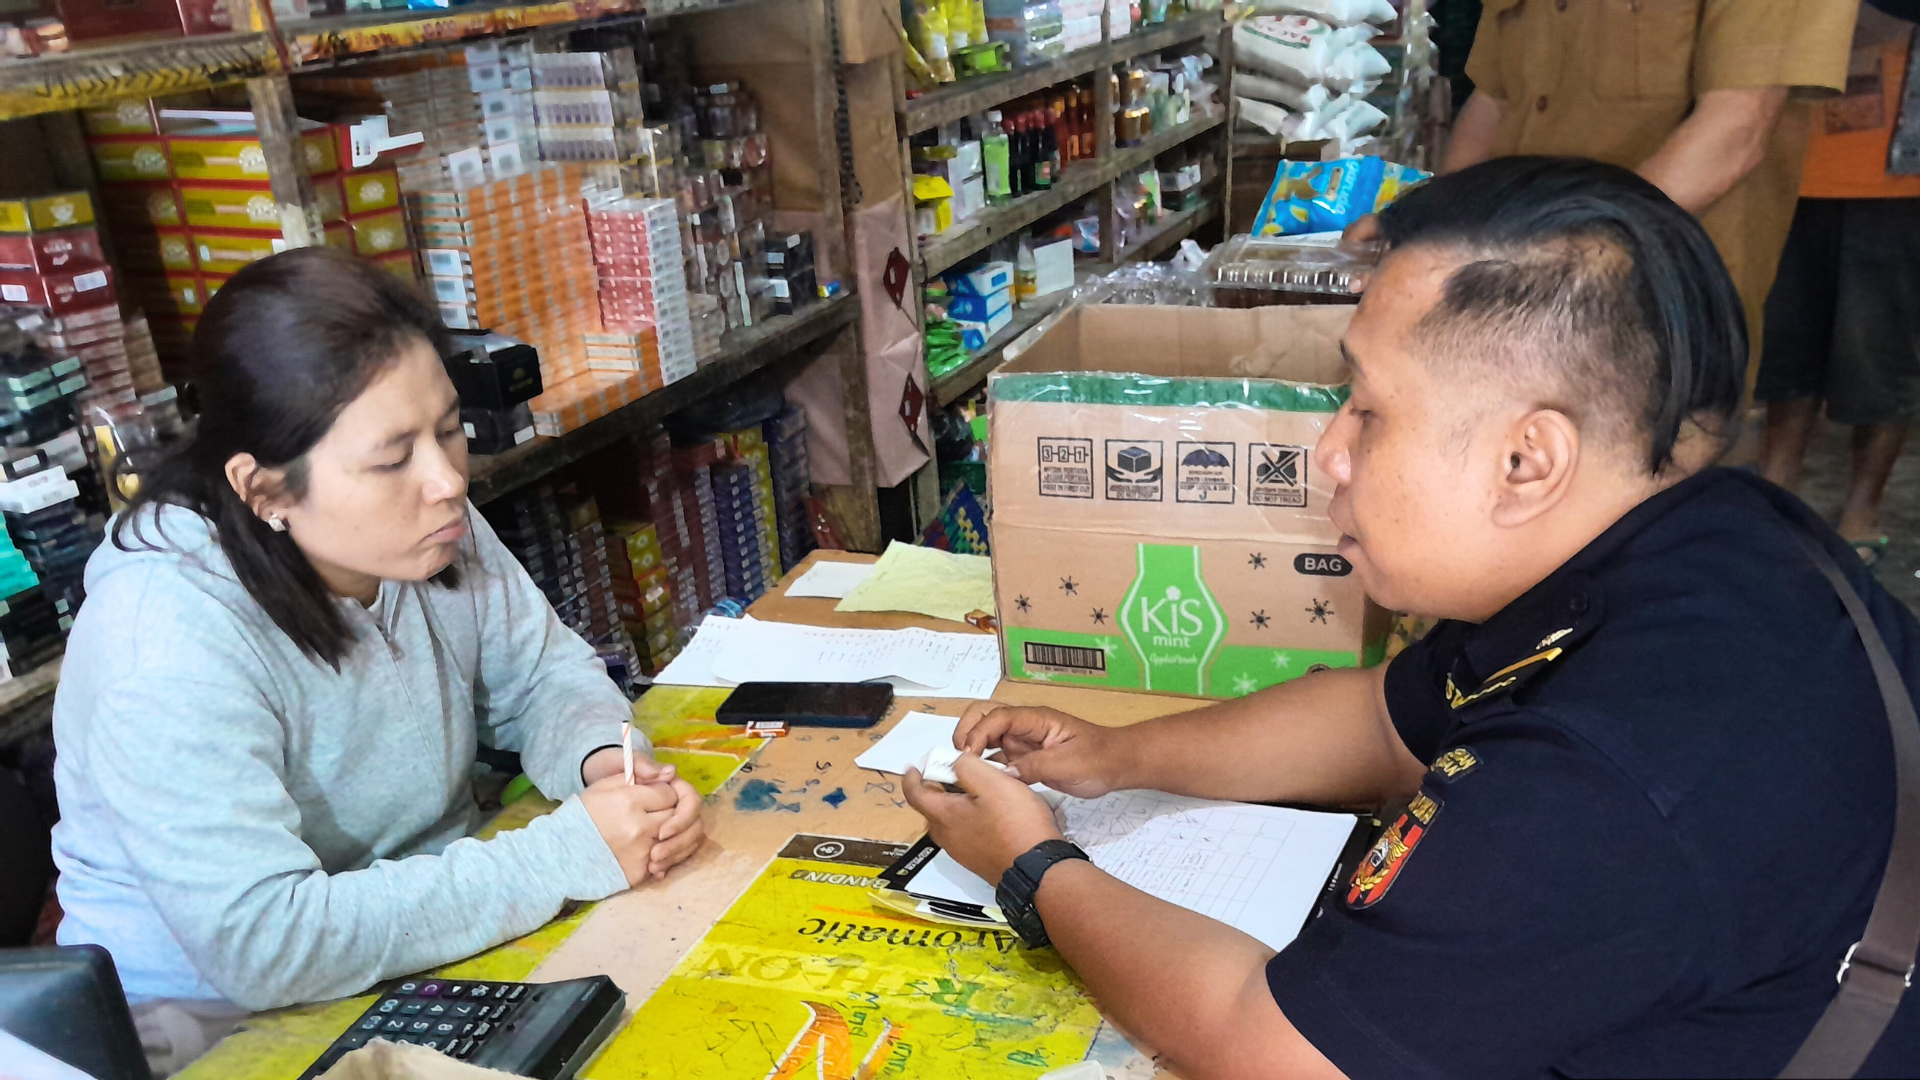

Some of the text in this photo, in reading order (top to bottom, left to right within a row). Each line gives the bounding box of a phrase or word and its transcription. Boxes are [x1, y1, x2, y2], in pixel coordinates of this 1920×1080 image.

[1304, 557, 1342, 572] BAG
[1153, 634, 1191, 648] mint
[797, 917, 1017, 955] Aromatic
[424, 984, 438, 993] C
[430, 1004, 444, 1012] 4
[456, 1006, 471, 1014] 7
[387, 1020, 404, 1028] 2
[413, 1021, 429, 1029] 5
[438, 1023, 453, 1031] 8
